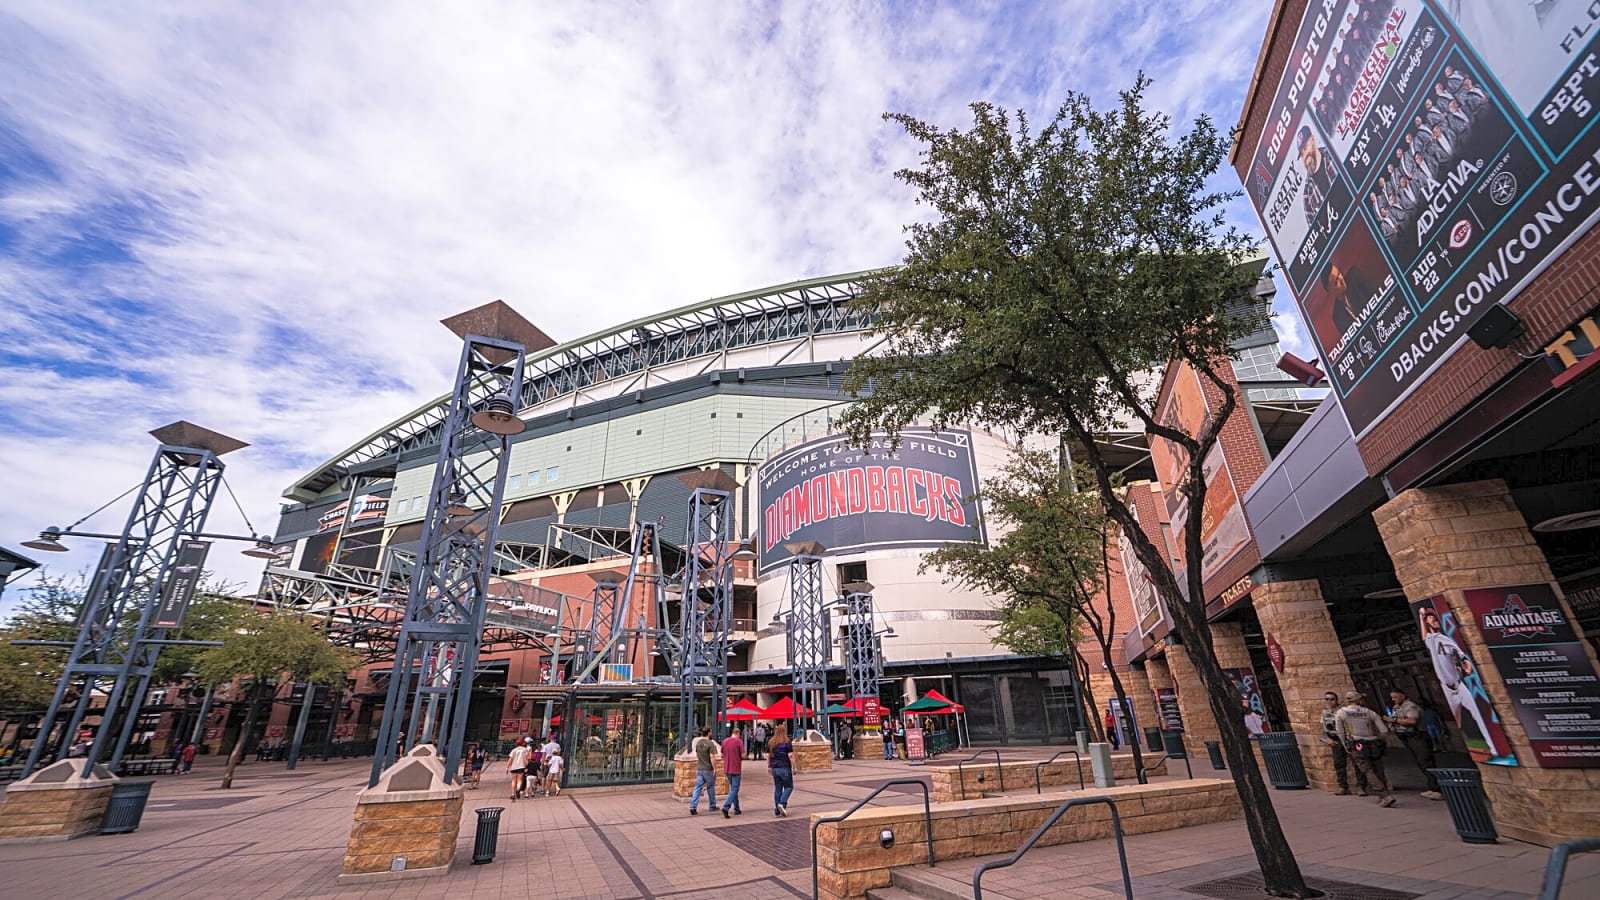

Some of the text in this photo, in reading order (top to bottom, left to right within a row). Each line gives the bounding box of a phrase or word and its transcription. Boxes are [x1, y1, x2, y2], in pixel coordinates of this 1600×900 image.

[1397, 38, 1415, 70] PRESENTED
[1397, 46, 1423, 94] Wendy's
[1337, 7, 1405, 136] LA ORIGINAL
[1541, 52, 1600, 125] SEPT
[1348, 93, 1371, 133] BANDA
[1571, 95, 1592, 118] 5
[1267, 106, 1291, 165] 2025
[1350, 127, 1371, 168] MAY
[1361, 152, 1371, 166] 9
[1269, 160, 1299, 225] SCOTTY
[1421, 176, 1441, 202] LA
[1477, 161, 1504, 194] PRESENTED
[1272, 171, 1303, 235] HASTING
[1299, 229, 1319, 265] APRIL
[1308, 247, 1318, 265] 25
[1390, 147, 1600, 383] DBACKS.COM/CONCE
[1412, 251, 1437, 286] AUG
[1423, 270, 1440, 293] 22
[1328, 274, 1395, 361] TAUREN WELLS
[1338, 351, 1355, 376] AUG
[1347, 368, 1355, 381] 8
[765, 451, 818, 490] WELCOME
[823, 446, 842, 457] TO
[910, 442, 958, 459] FIELD
[801, 452, 901, 477] HOME OF THE
[364, 501, 386, 510] FIELD
[765, 465, 967, 553] DIAMONDBACKS
[1220, 574, 1252, 607] TICKETS
[1484, 611, 1562, 627] ADVANTAGE
[1508, 626, 1545, 634] MEMBER
[1513, 656, 1540, 664] TICKET
